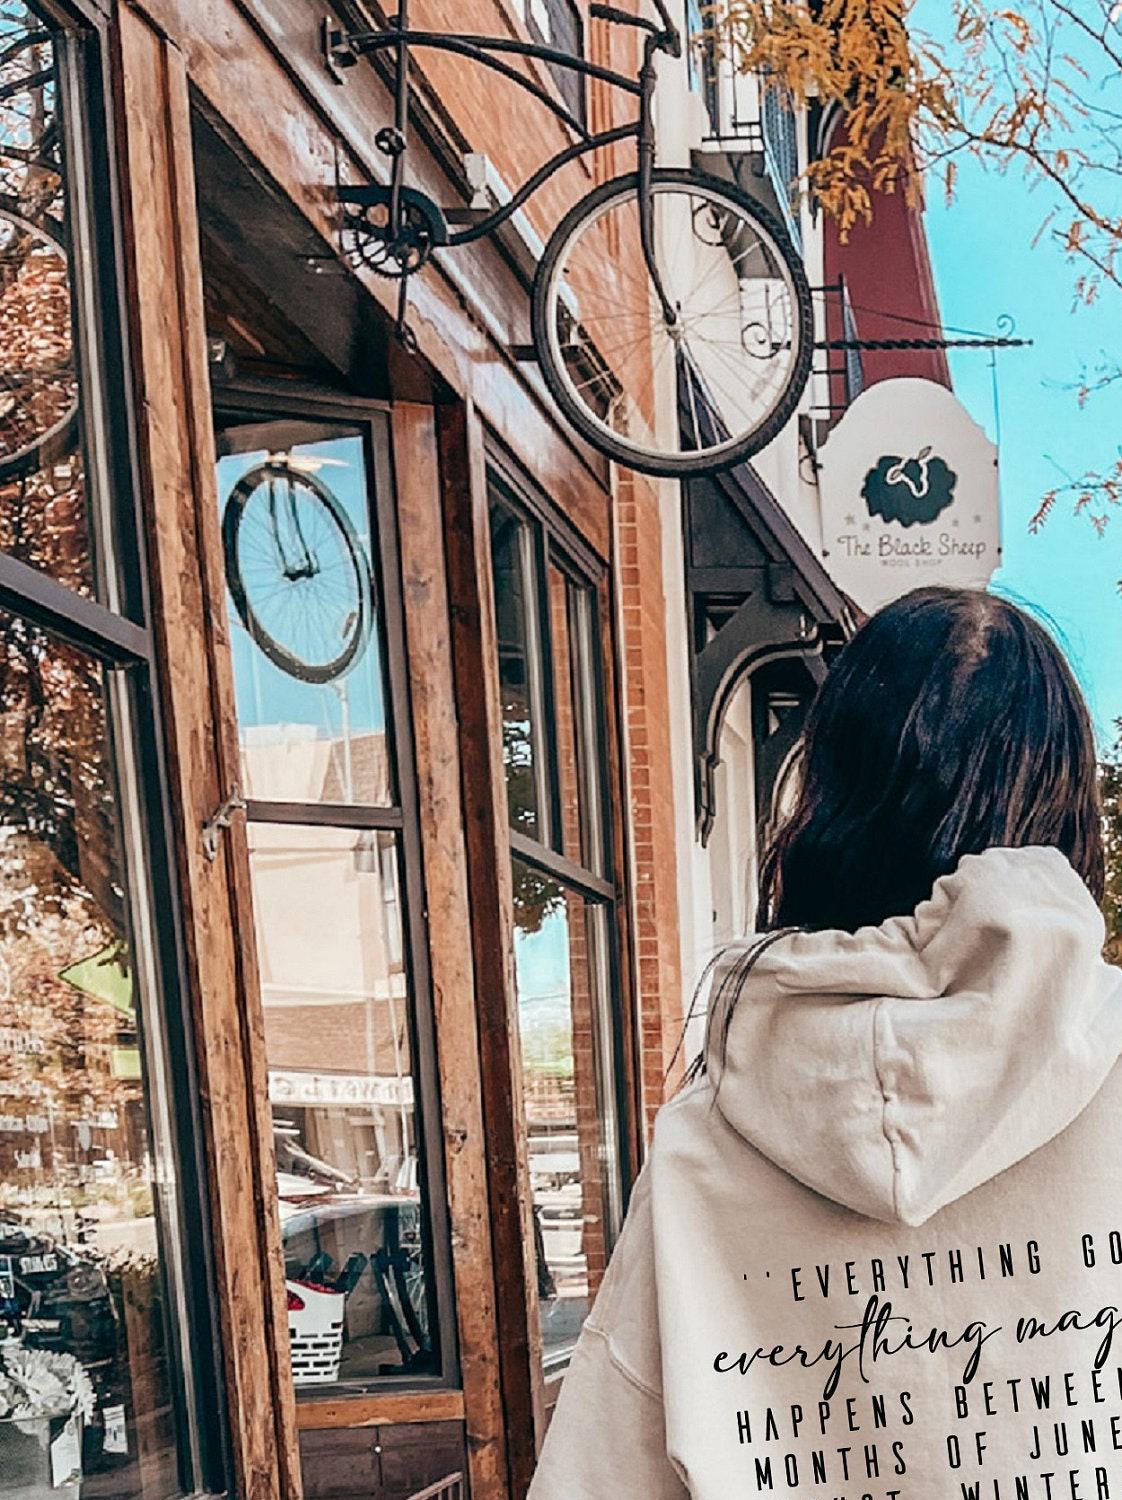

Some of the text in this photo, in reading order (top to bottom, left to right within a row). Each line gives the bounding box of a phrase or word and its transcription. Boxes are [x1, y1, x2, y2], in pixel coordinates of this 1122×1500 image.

[837, 533, 987, 560] The Black Sheep
[713, 1294, 1003, 1401] everything
[736, 1391, 914, 1444] HAPPENS
[754, 1441, 907, 1491] MONTHS
[946, 1431, 988, 1469] OF
